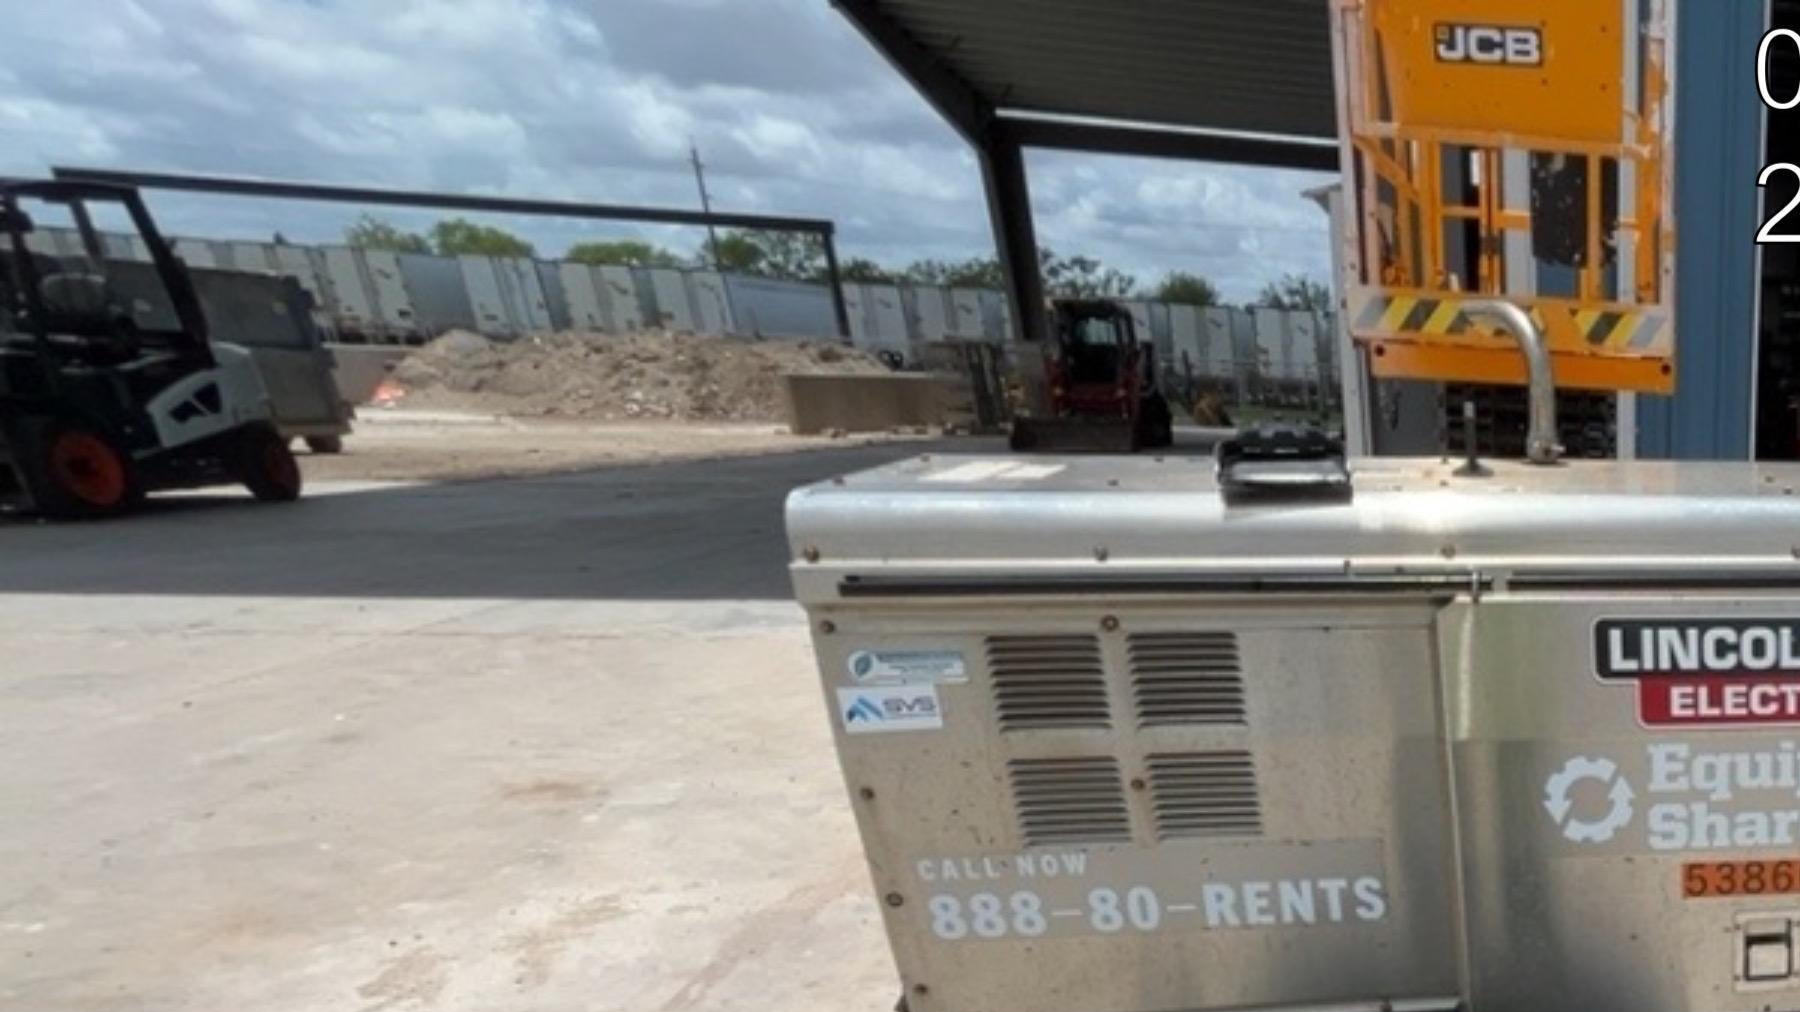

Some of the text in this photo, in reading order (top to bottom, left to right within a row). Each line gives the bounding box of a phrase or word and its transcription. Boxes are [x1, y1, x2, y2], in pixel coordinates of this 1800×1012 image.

[1436, 26, 1542, 65] JCB
[916, 852, 1090, 881] CALL NOW
[928, 876, 1388, 940] 888-80-RENTS
